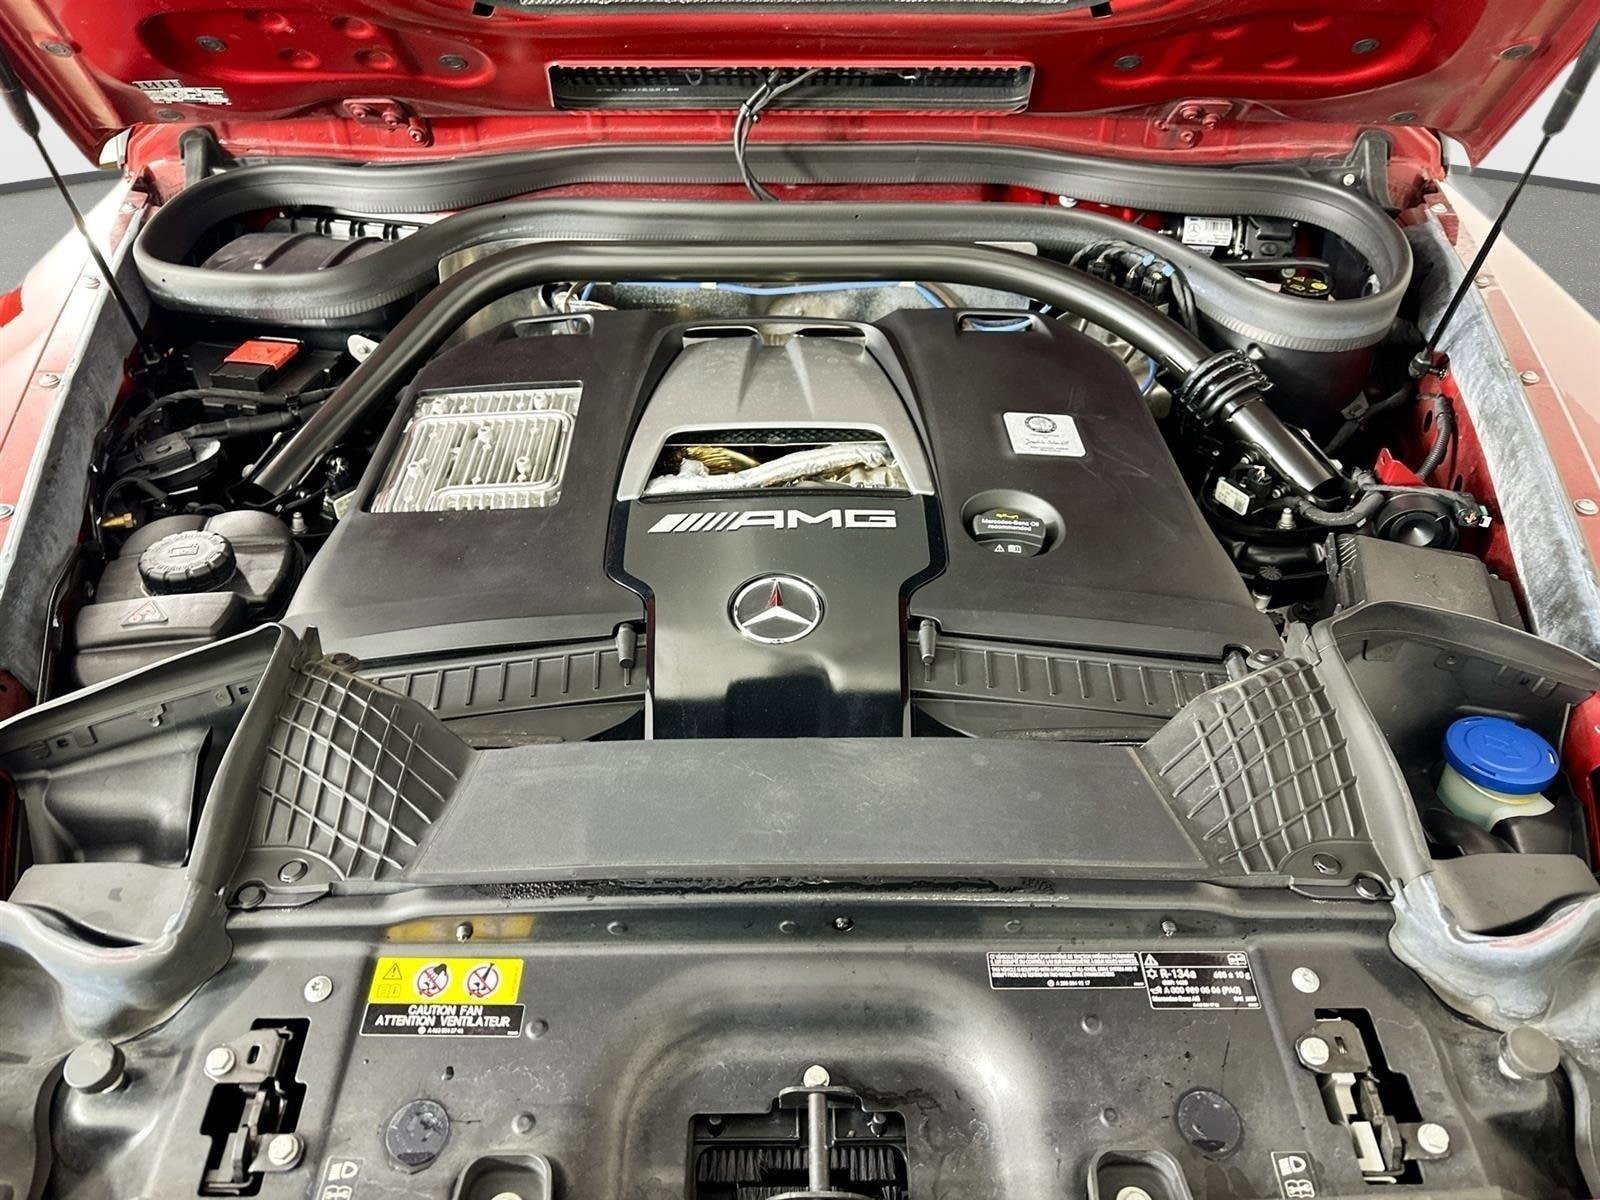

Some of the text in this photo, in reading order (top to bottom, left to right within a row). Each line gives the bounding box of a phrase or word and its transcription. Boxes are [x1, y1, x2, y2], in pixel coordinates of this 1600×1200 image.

[727, 509, 897, 530] AMG
[1160, 969, 1197, 979] R-134a
[408, 1005, 484, 1016] CAUTION FAN
[374, 1015, 511, 1027] ATTENTION VENTILATEUR
